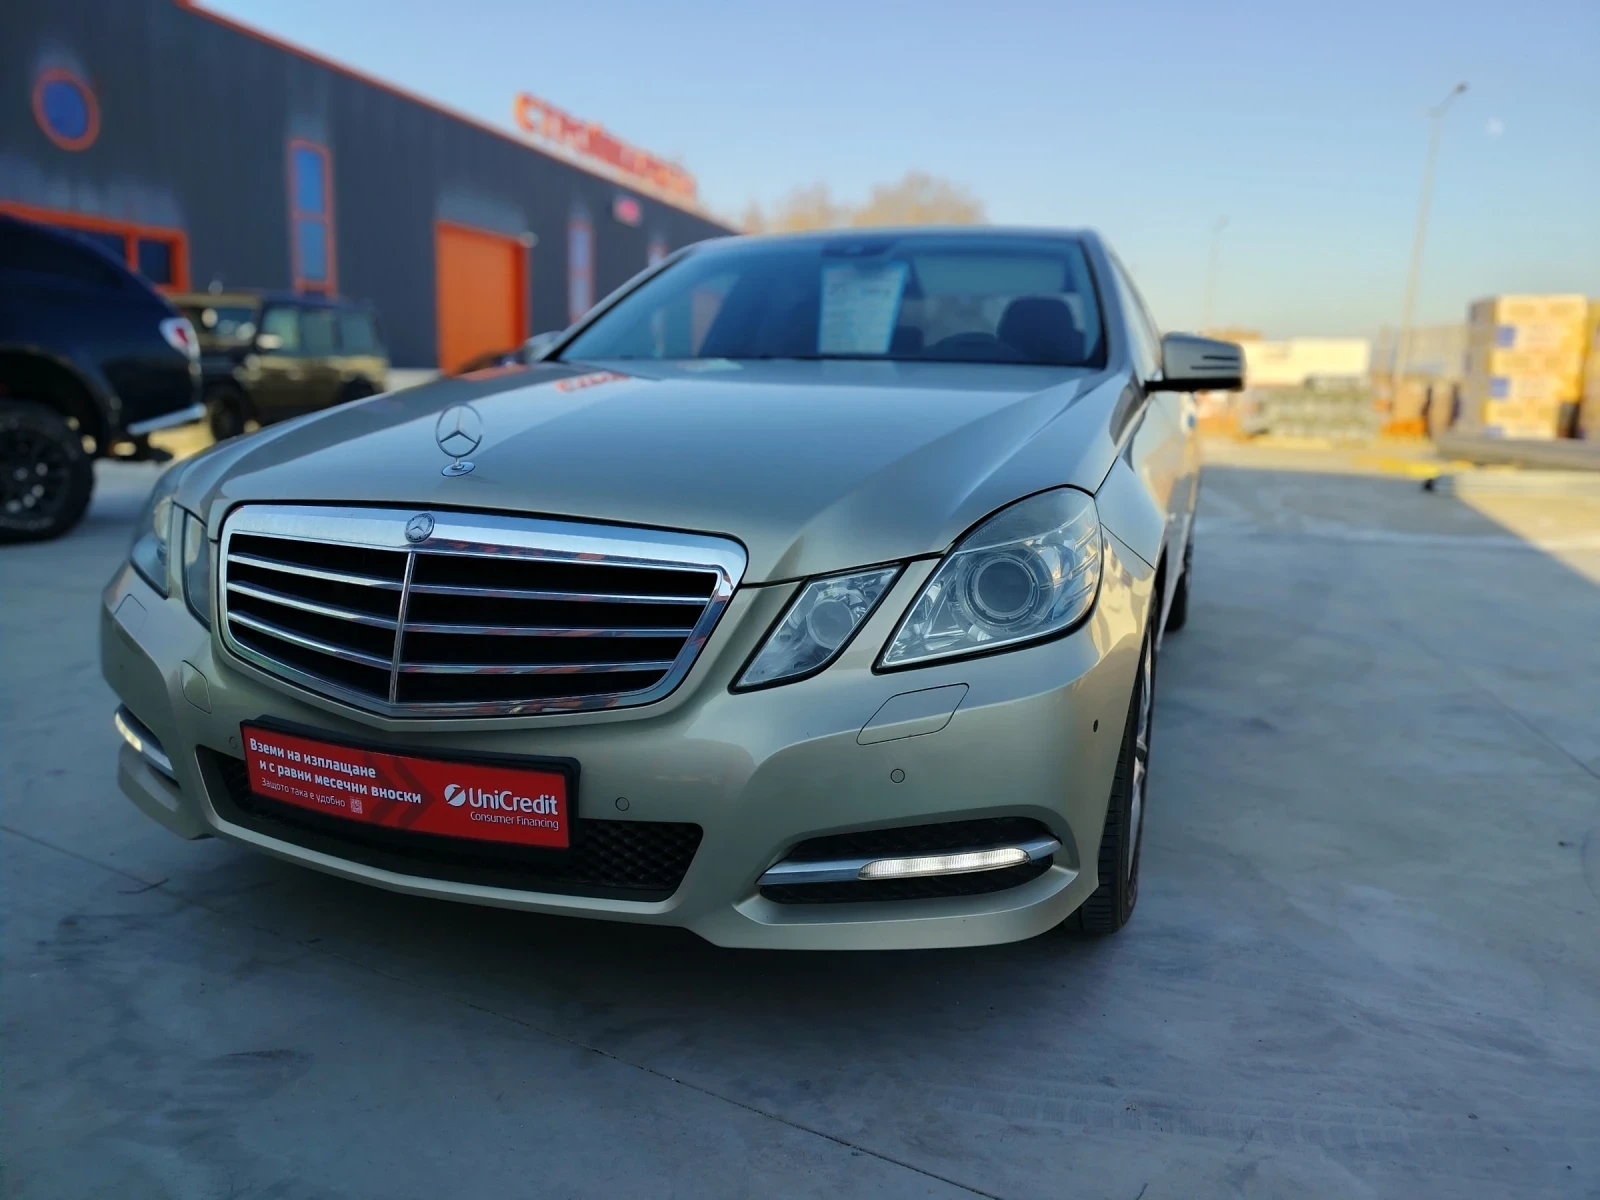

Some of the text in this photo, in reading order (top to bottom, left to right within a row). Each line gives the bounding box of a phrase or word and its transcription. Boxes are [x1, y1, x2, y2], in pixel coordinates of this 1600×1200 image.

[249, 737, 376, 778] Вземи на изплащане
[259, 760, 422, 804] и с равни месечни вноски
[261, 777, 346, 808] Защото така е удобно
[468, 787, 559, 815] UniCredit
[470, 811, 560, 831] Consumer Financing
